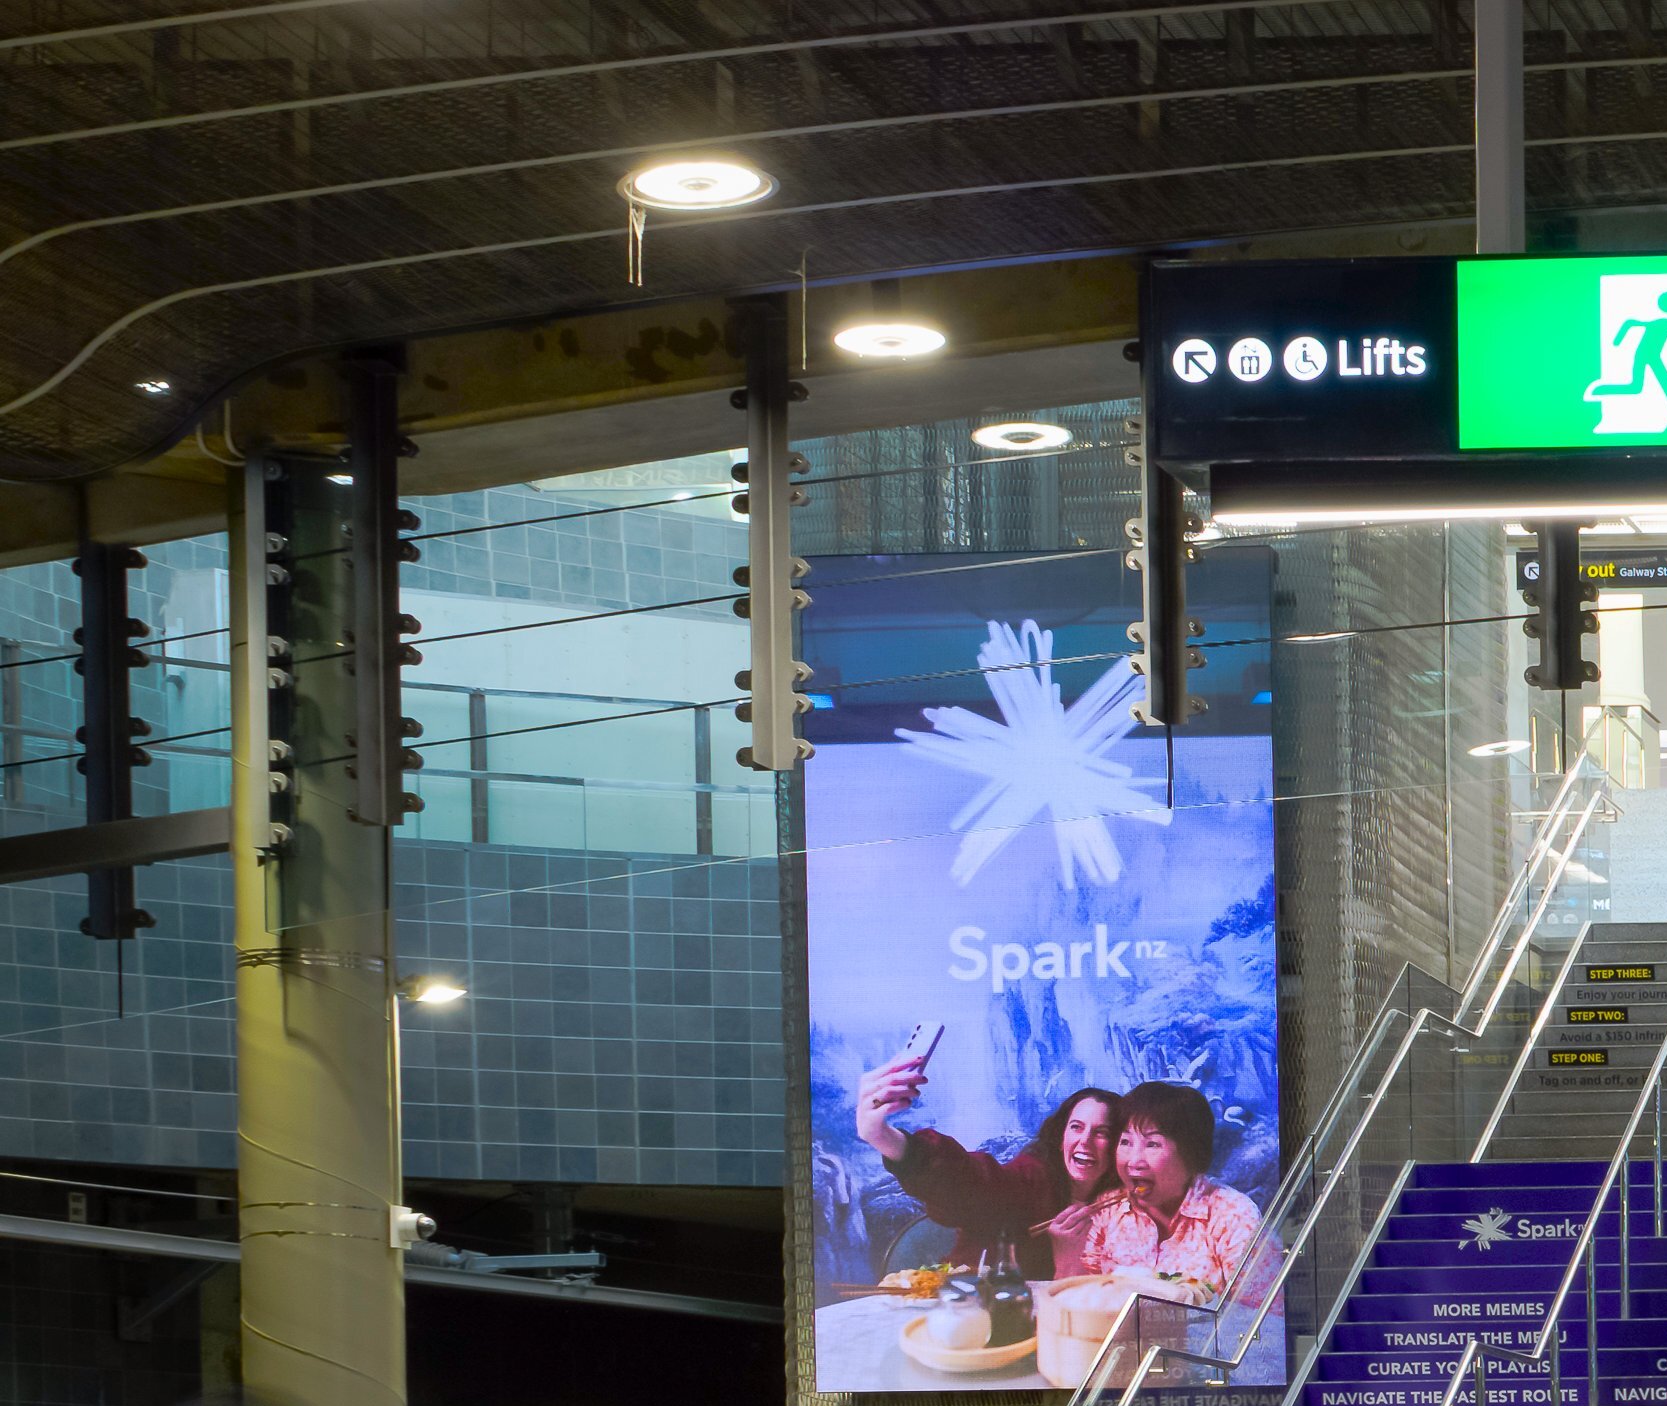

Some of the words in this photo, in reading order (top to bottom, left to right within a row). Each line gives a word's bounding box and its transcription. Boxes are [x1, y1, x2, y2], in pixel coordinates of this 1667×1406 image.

[1337, 335, 1427, 377] Lifts
[1587, 562, 1615, 578] out
[1619, 567, 1655, 579] Galway
[1590, 969, 1615, 980] STEP
[1616, 968, 1652, 979] THREE:
[1576, 989, 1607, 1001] Enjoy
[1610, 991, 1636, 1001] your
[1570, 1011, 1596, 1021] STEP
[1598, 1011, 1625, 1021] TWO:
[1559, 1032, 1593, 1043] Avoid
[1594, 1034, 1601, 1042] a
[1605, 1031, 1632, 1042] $150
[1552, 1053, 1578, 1064] STEP
[1579, 1053, 1605, 1063] ONE:
[1539, 1076, 1560, 1087] Tag
[1562, 1077, 1577, 1085] on
[1579, 1074, 1601, 1085] and
[1433, 1303, 1481, 1317] MORE
[1486, 1302, 1545, 1316] MEMES
[1384, 1332, 1475, 1346] TRANSLATE
[1481, 1331, 1513, 1345] THE
[1367, 1362, 1431, 1376] CURATE
[1322, 1391, 1406, 1406] NAVIGATE
[1410, 1391, 1443, 1405] THE
